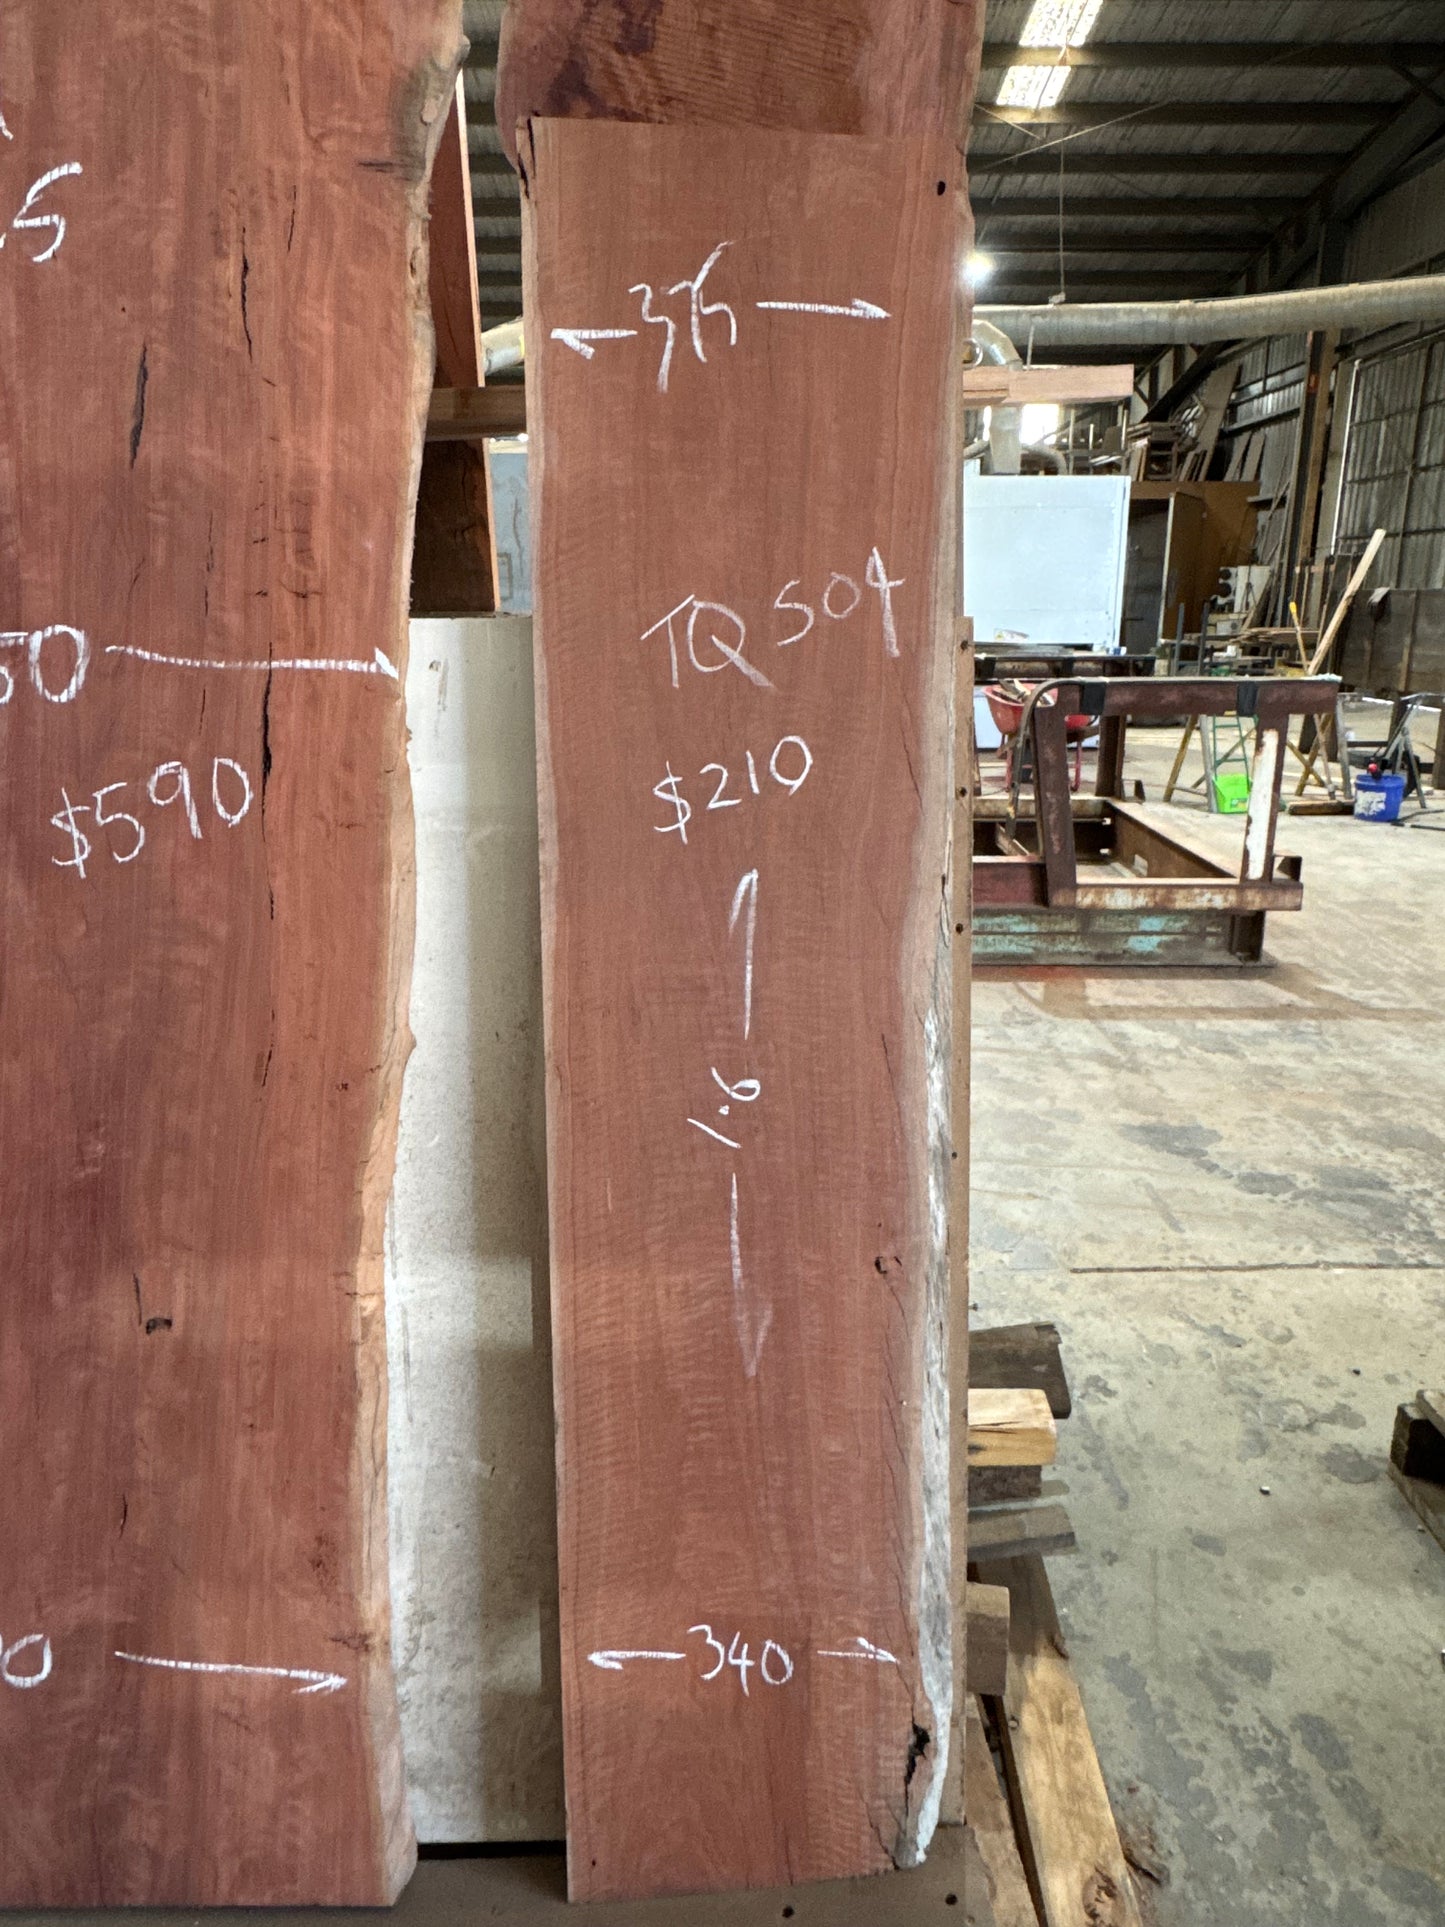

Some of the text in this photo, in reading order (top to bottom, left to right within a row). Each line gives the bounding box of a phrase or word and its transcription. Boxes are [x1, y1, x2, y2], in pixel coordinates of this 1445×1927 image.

[640, 546, 906, 688] TQ 504
[51, 757, 254, 879] $590
[652, 735, 813, 845] $210
[0, 1633, 52, 1688] 0
[687, 1624, 794, 1697] 340
